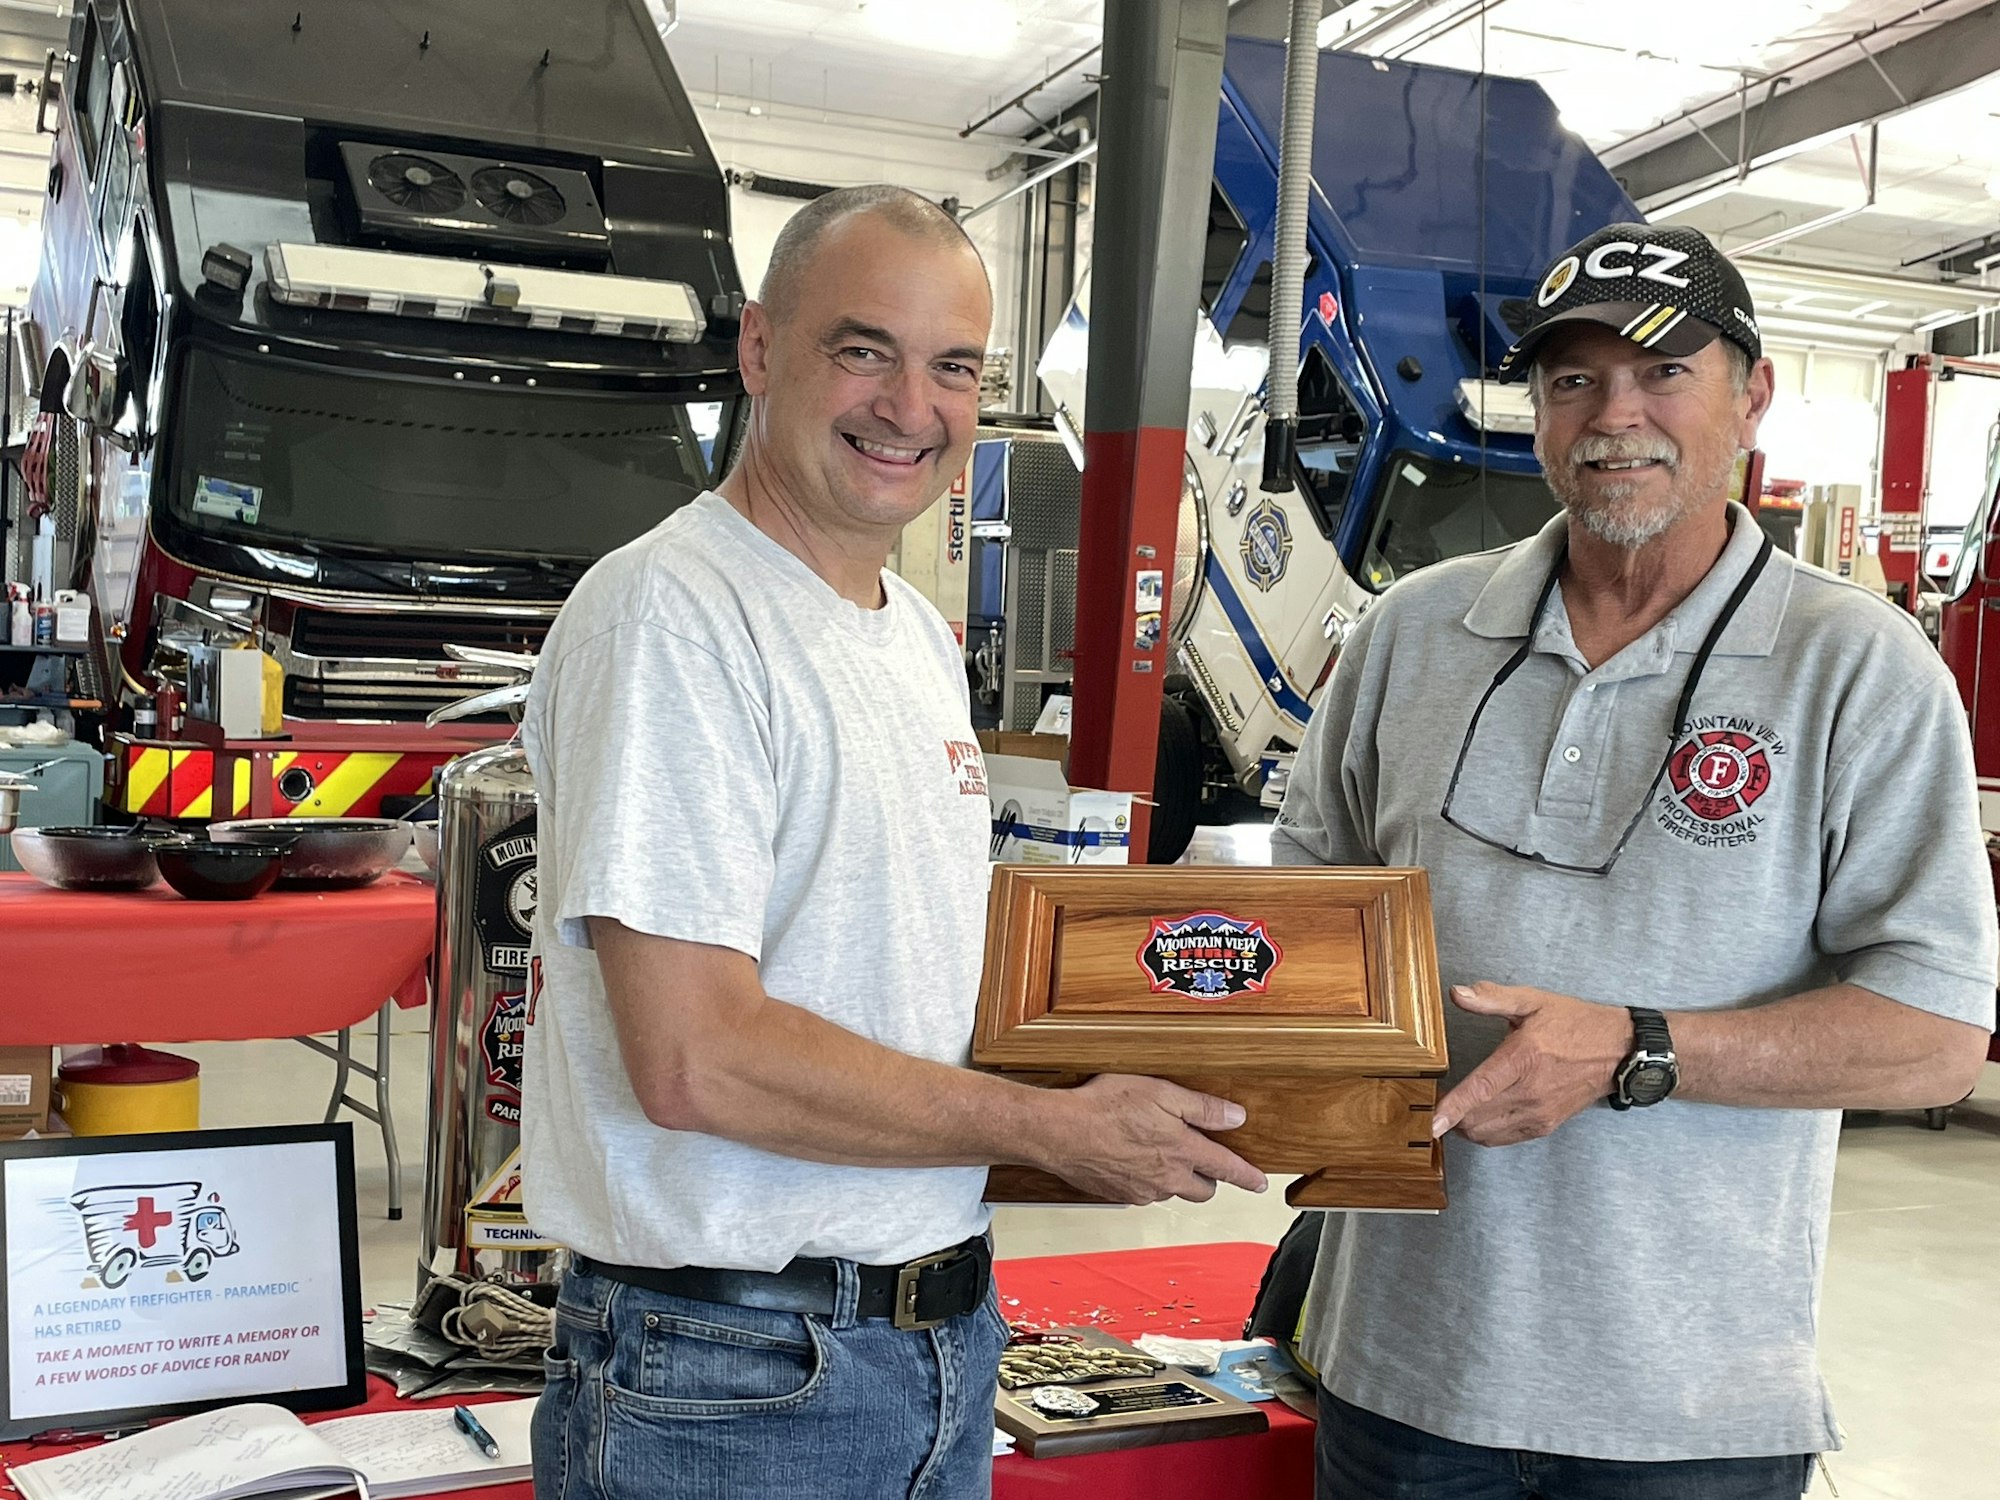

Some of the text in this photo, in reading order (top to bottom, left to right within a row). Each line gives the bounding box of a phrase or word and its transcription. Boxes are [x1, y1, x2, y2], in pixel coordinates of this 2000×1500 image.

[1585, 241, 1690, 288] CZ
[949, 498, 965, 561] stertil
[1680, 716, 1787, 756] OUNTAIN VIEW
[1706, 755, 1731, 785] F
[1657, 814, 1757, 848] FIREFIGHTERS
[1659, 794, 1765, 835] PROFESSIONAL
[495, 950, 527, 966] FIRE
[1156, 937, 1261, 953] MOUNTAIN VIEW
[1179, 949, 1238, 959] FIRE
[1161, 958, 1258, 974] RESCUE
[34, 1304, 43, 1316] A
[47, 1297, 126, 1315] LEGENDARY
[130, 1289, 212, 1307] FIREFIGHTER
[224, 1281, 299, 1299] PARAMEDIC
[35, 1319, 121, 1338] HAS RETIRED
[36, 1325, 320, 1363] TAKE A MOMENT TO WRITE A MEMORY OR
[35, 1349, 290, 1386] A FEW WORDS OF ADVICE FOR RANDY
